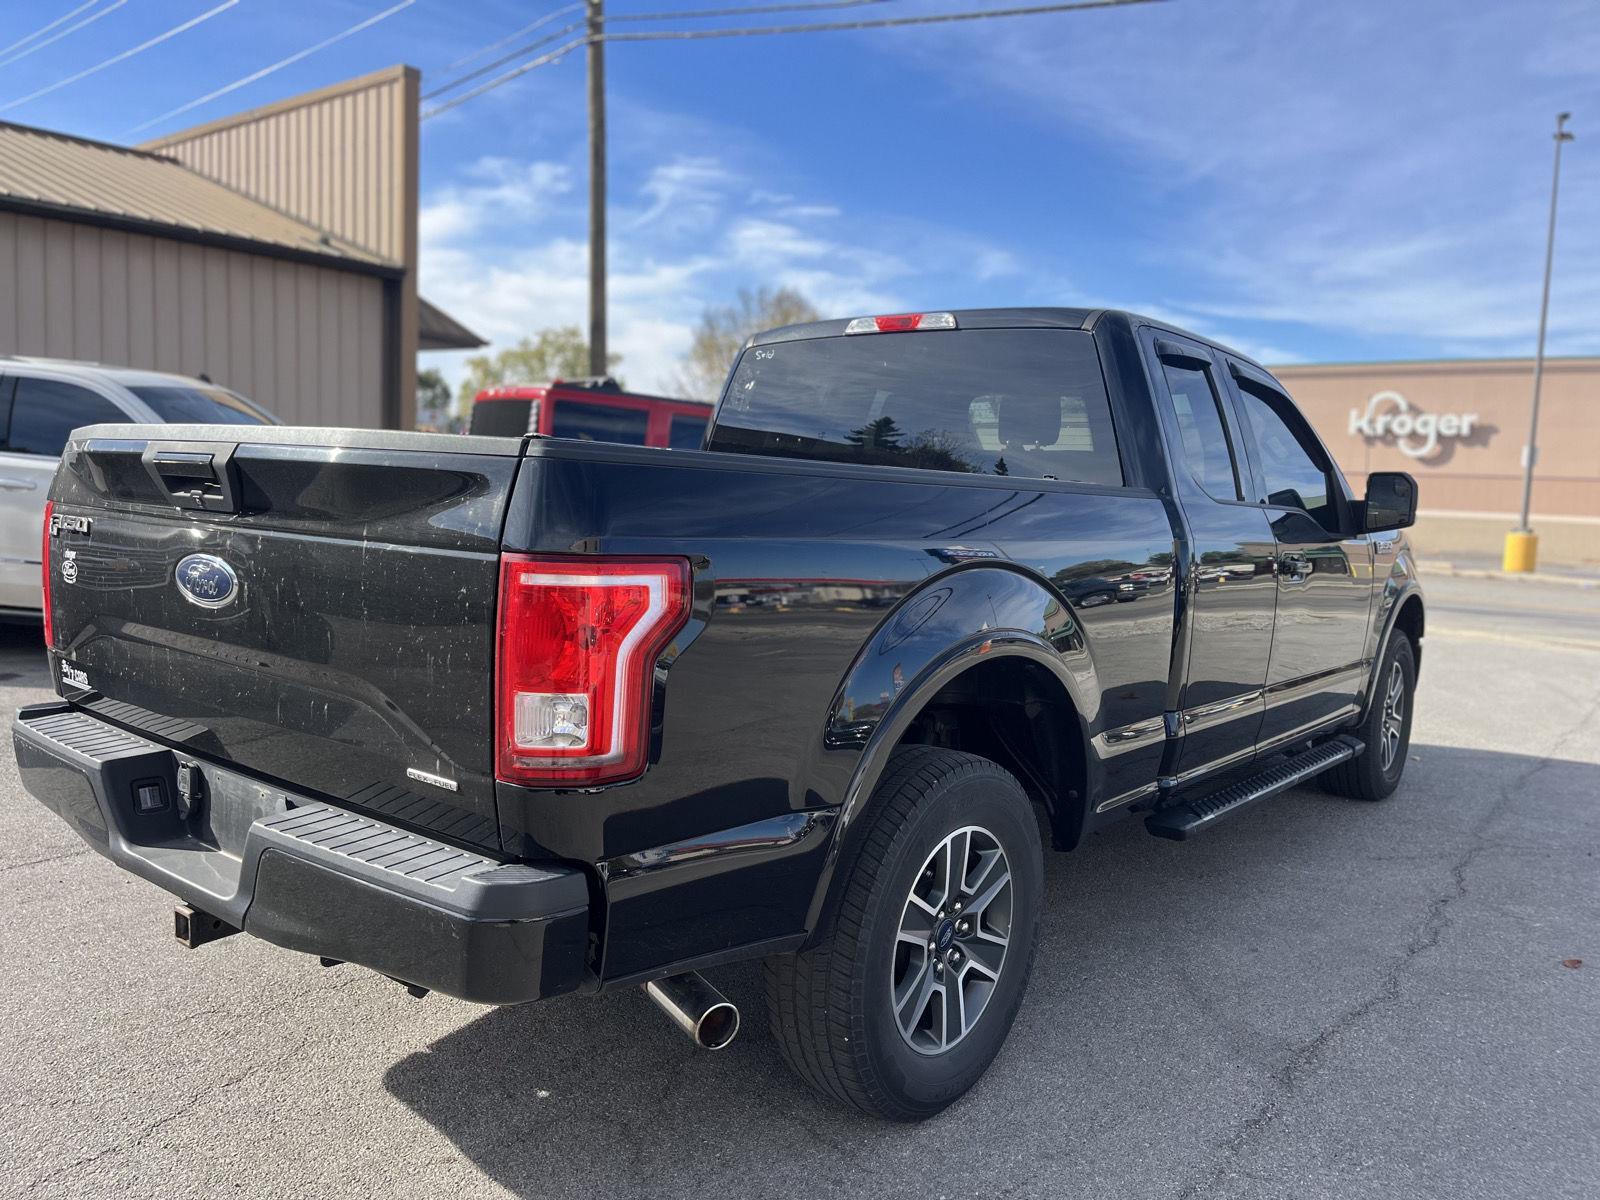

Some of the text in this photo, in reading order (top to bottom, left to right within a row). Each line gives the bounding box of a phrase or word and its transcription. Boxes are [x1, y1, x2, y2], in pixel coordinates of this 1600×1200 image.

[1348, 390, 1478, 458] Kroger
[186, 563, 219, 596] Ford
[434, 779, 457, 791] FUEL
